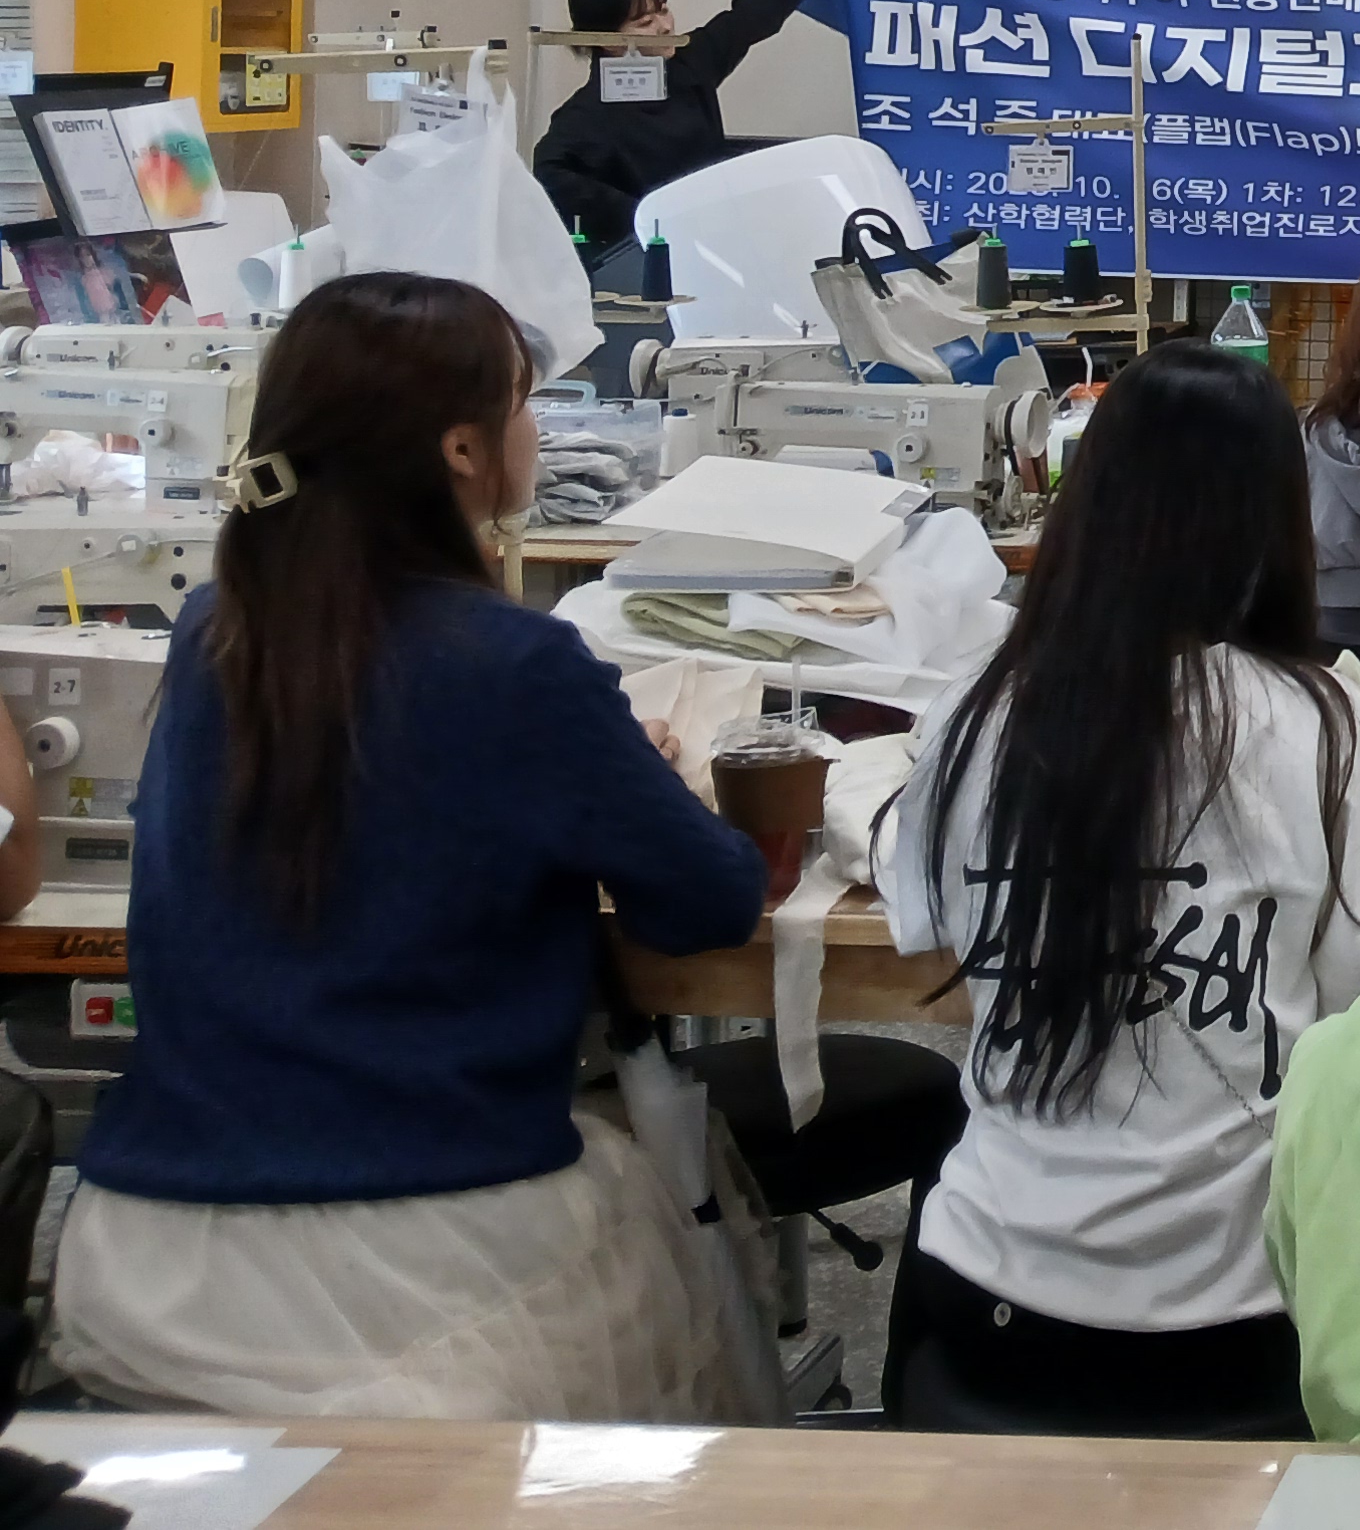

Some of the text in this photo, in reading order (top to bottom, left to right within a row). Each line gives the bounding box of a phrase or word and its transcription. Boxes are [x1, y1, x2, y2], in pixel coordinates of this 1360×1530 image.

[865, 0, 1050, 77] 패션
[901, 168, 953, 195] 시:
[1152, 177, 1228, 205] 6(목)
[1243, 181, 1303, 207] 1차:
[913, 200, 950, 226] 최:
[963, 202, 1133, 235] 산학협력단,
[55, 933, 127, 959] Unic
